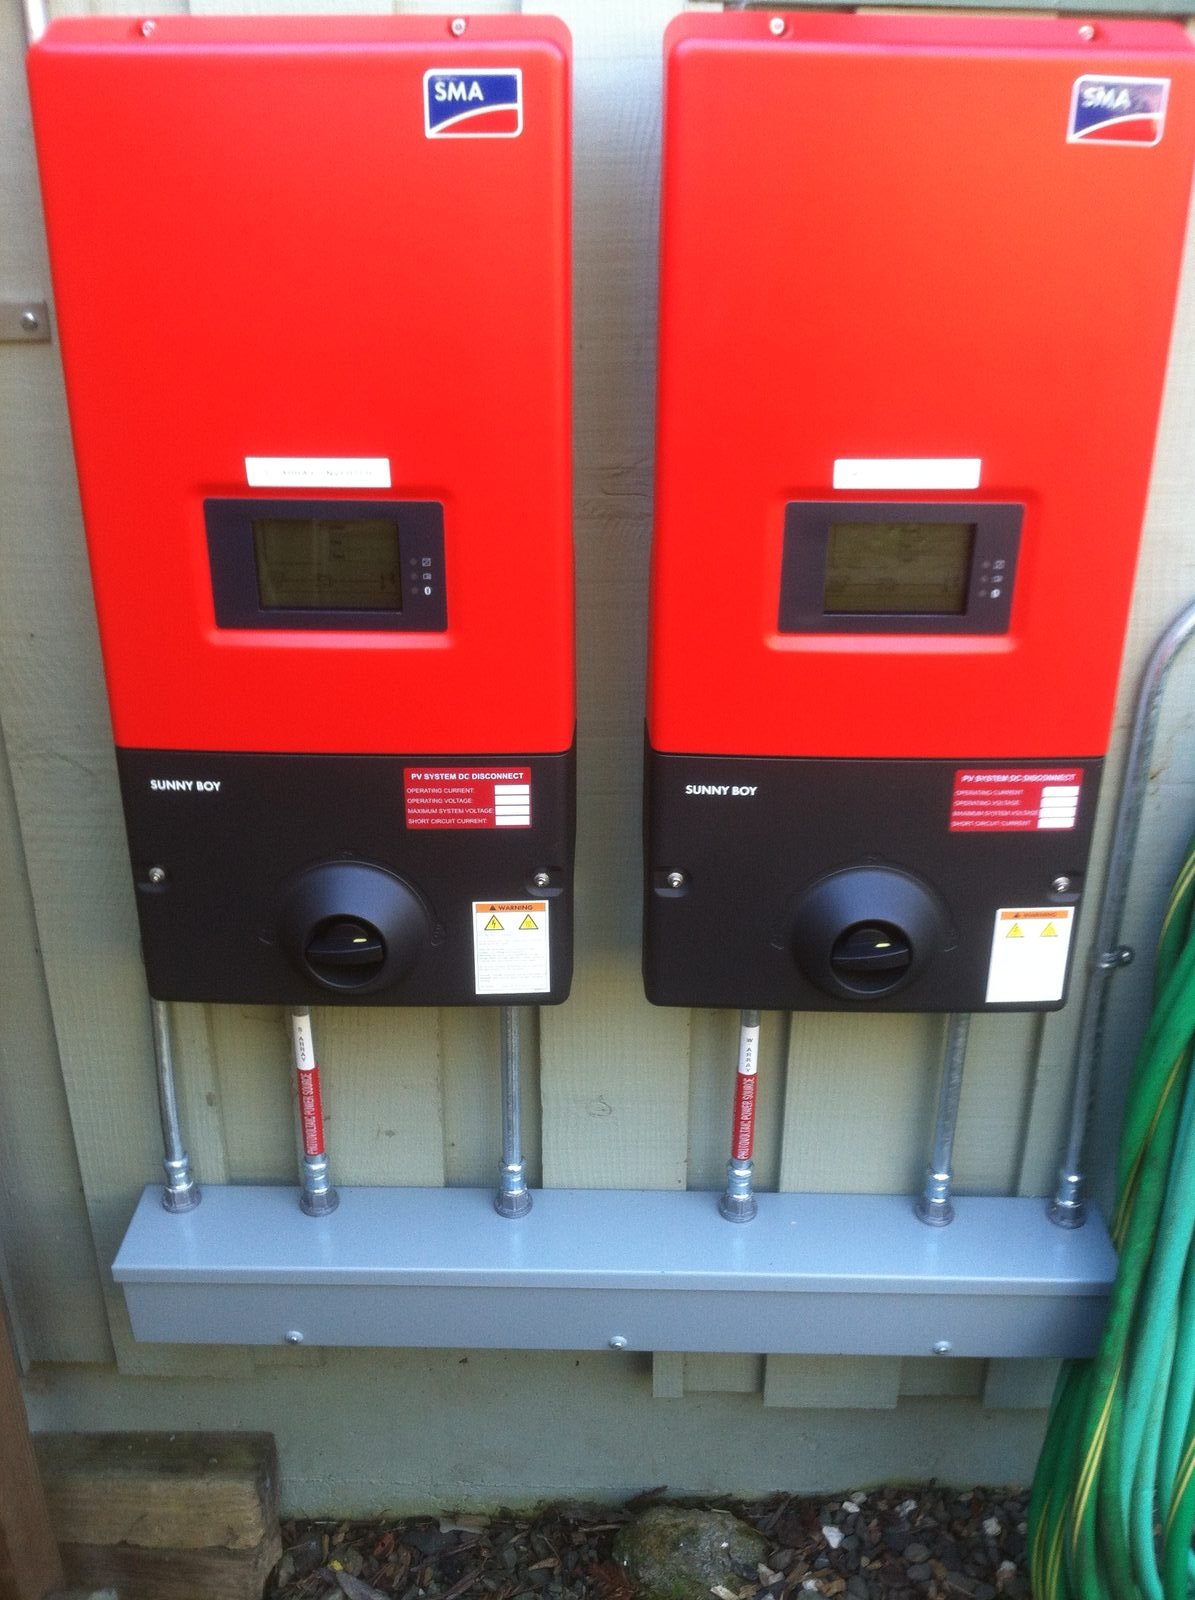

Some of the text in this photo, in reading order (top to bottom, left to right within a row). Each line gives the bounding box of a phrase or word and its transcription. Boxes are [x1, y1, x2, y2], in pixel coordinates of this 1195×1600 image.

[434, 81, 484, 102] SMA
[1082, 86, 1131, 109] SMA
[150, 780, 220, 792] SUNNY BOY
[1024, 774, 1076, 782] DISCONNECT
[685, 784, 758, 796] SUNNY BOY
[301, 1073, 313, 1095] SOURCE
[303, 1096, 315, 1115] POWER
[740, 1101, 752, 1120] POWER
